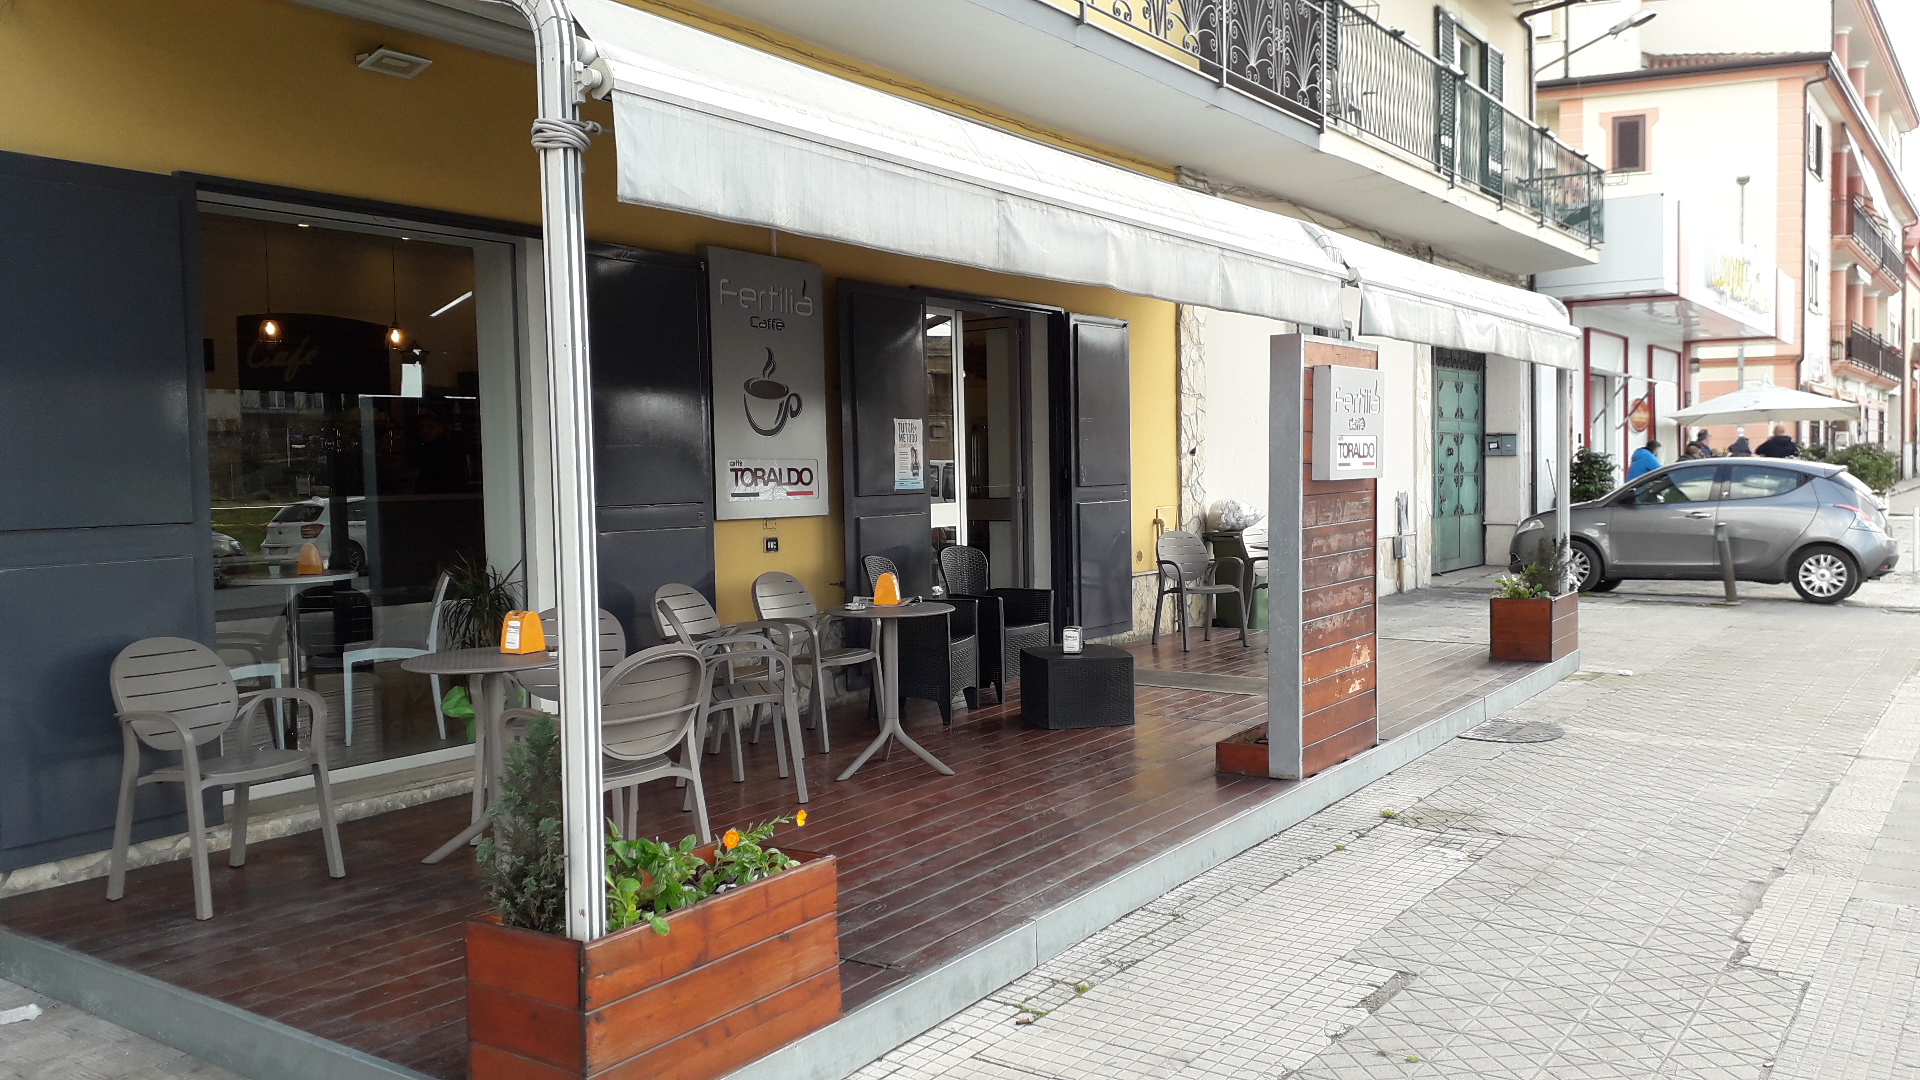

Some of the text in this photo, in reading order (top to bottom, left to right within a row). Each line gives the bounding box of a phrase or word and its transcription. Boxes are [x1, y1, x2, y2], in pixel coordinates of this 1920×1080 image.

[750, 315, 785, 331] Caffè
[1337, 442, 1375, 459] TORALDO
[729, 467, 814, 487] TORALDO
